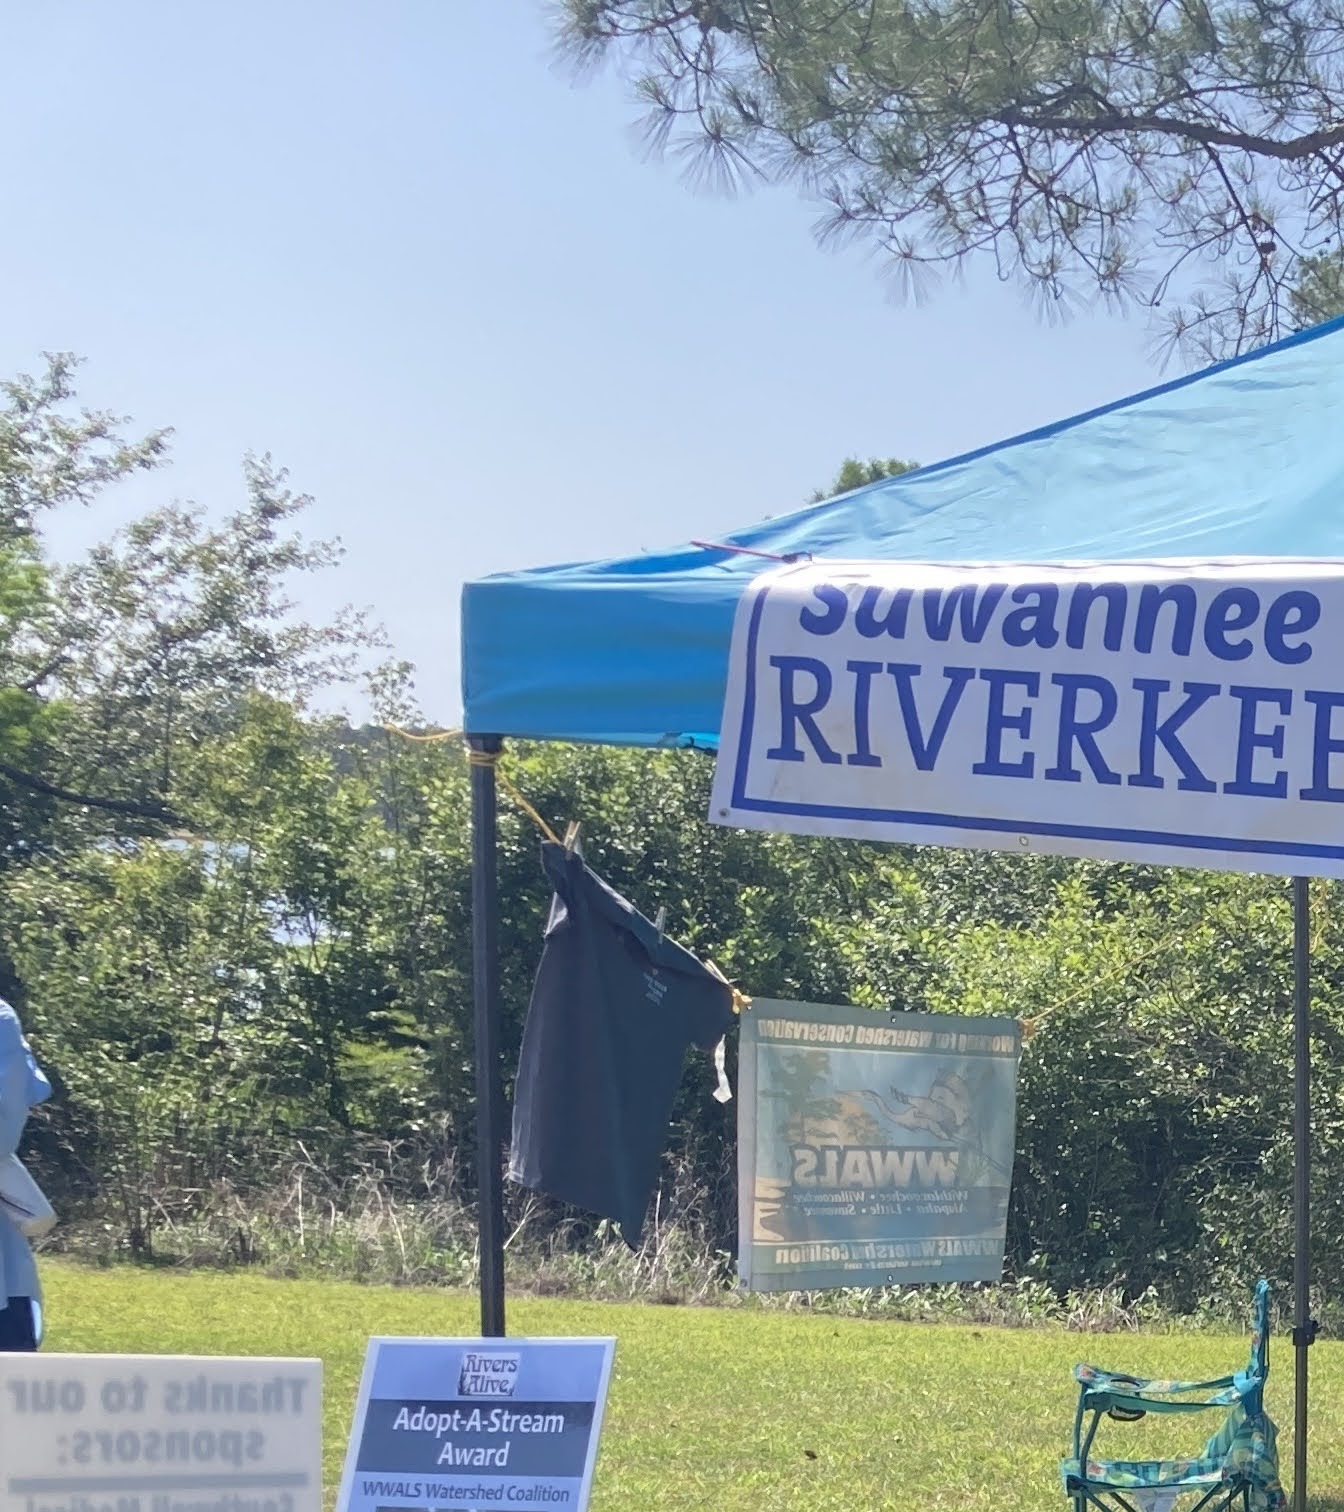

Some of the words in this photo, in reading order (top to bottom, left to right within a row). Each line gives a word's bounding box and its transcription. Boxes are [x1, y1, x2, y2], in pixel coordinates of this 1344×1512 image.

[464, 1354, 519, 1372] Rivers
[468, 1375, 510, 1393] Alive
[392, 1406, 565, 1439] Adopt-A-Stream
[437, 1441, 511, 1467] Award
[362, 1481, 423, 1499] WWALS
[425, 1483, 503, 1502] Watershed
[506, 1485, 570, 1503] Coalition
